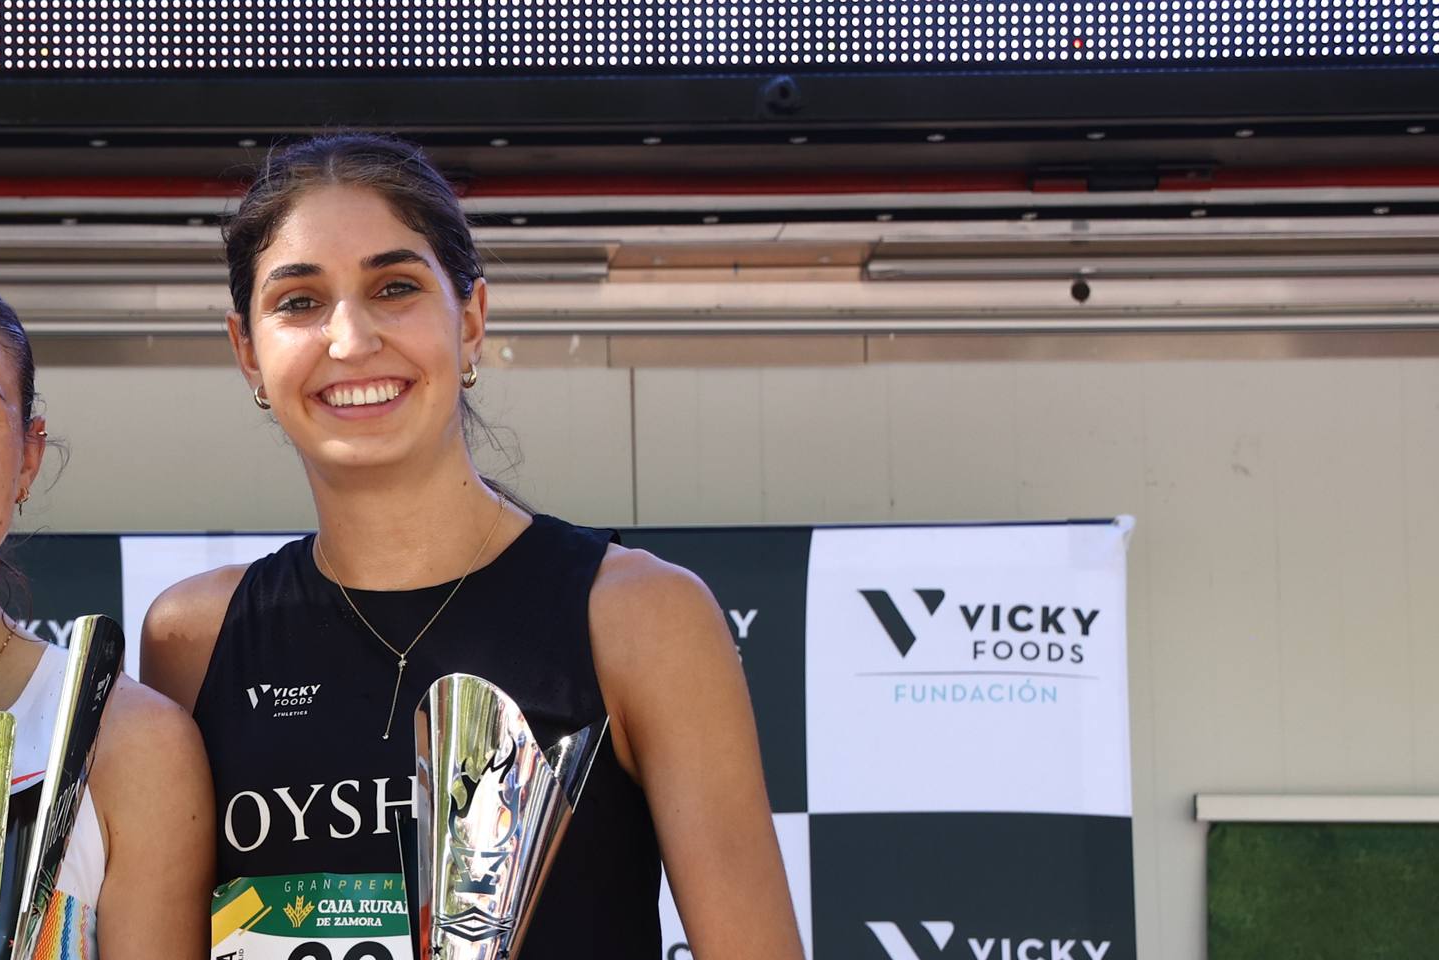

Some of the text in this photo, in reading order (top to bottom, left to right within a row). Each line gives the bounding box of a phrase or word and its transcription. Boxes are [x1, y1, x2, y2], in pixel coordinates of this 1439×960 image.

[960, 605, 1099, 636] VICKY
[974, 641, 1083, 663] FOODS
[273, 684, 321, 698] VICKY
[894, 680, 1057, 704] FUNDACIÓN
[274, 696, 313, 707] FOODS
[224, 774, 419, 853] OYSH
[317, 899, 355, 914] CAJA
[316, 917, 383, 927] DE ZAMORA
